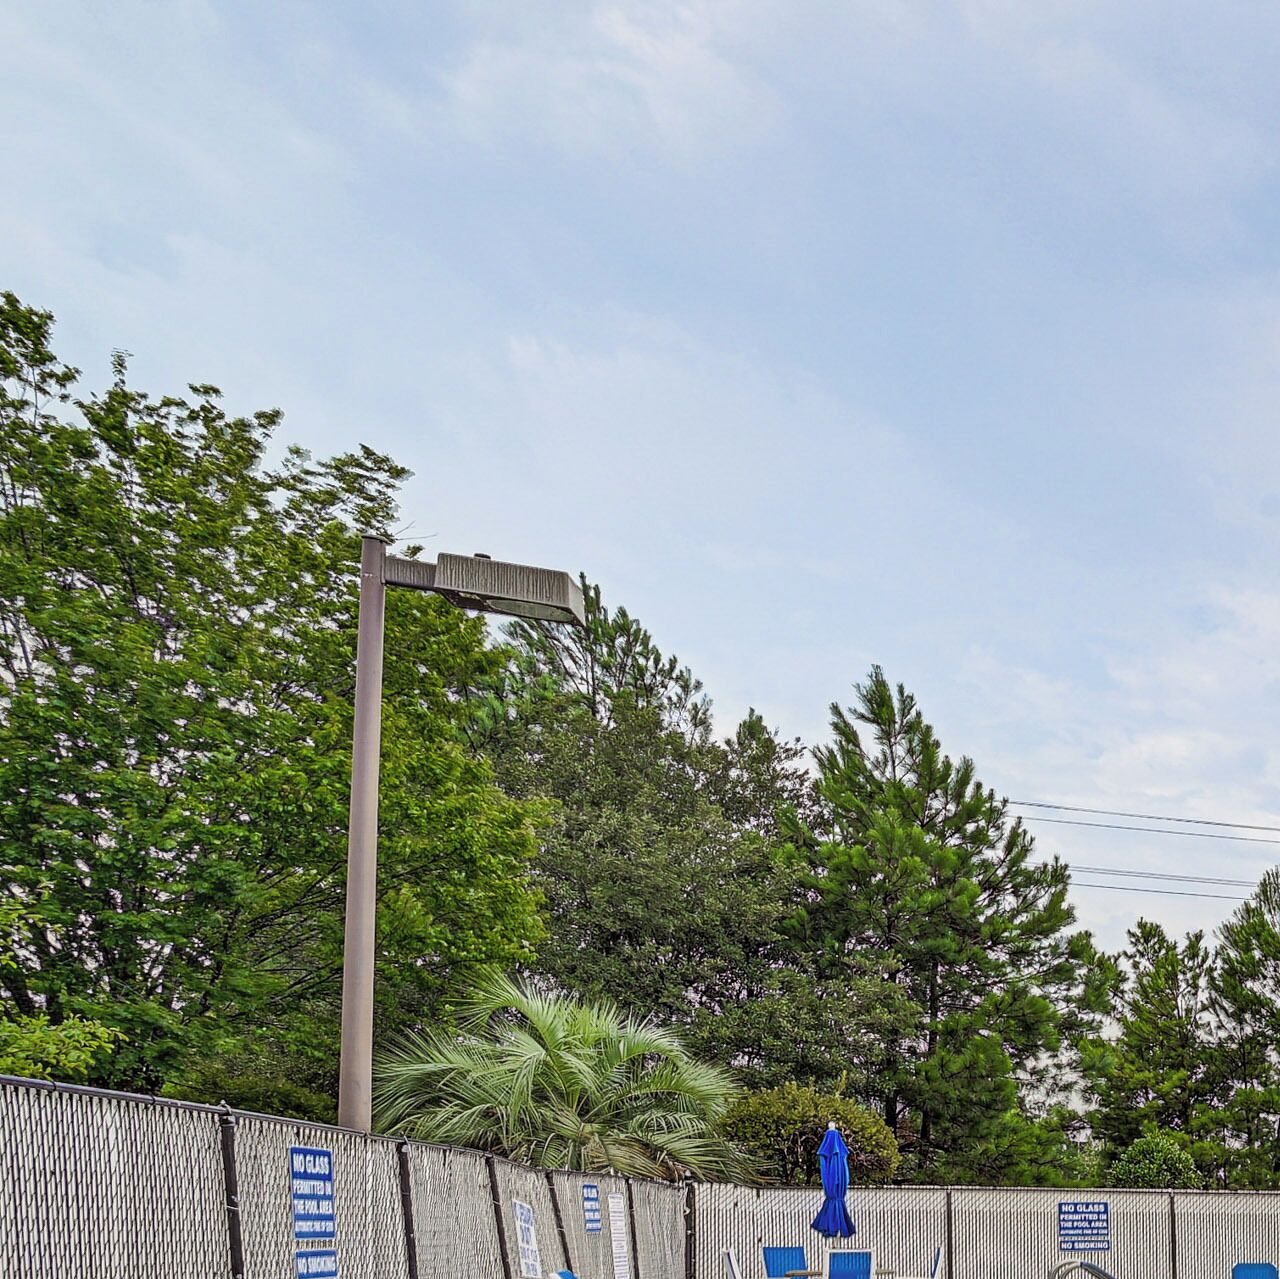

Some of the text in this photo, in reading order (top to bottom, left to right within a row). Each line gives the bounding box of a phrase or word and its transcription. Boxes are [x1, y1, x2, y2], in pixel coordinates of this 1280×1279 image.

[293, 1152, 330, 1175] NO GLASS
[293, 1180, 325, 1195] PERMITTED
[294, 1199, 333, 1215] THE POOL AREA
[1061, 1204, 1105, 1213] NO GLASS
[1073, 1241, 1108, 1249] SMOKING
[297, 1255, 336, 1274] NO SMOKING
